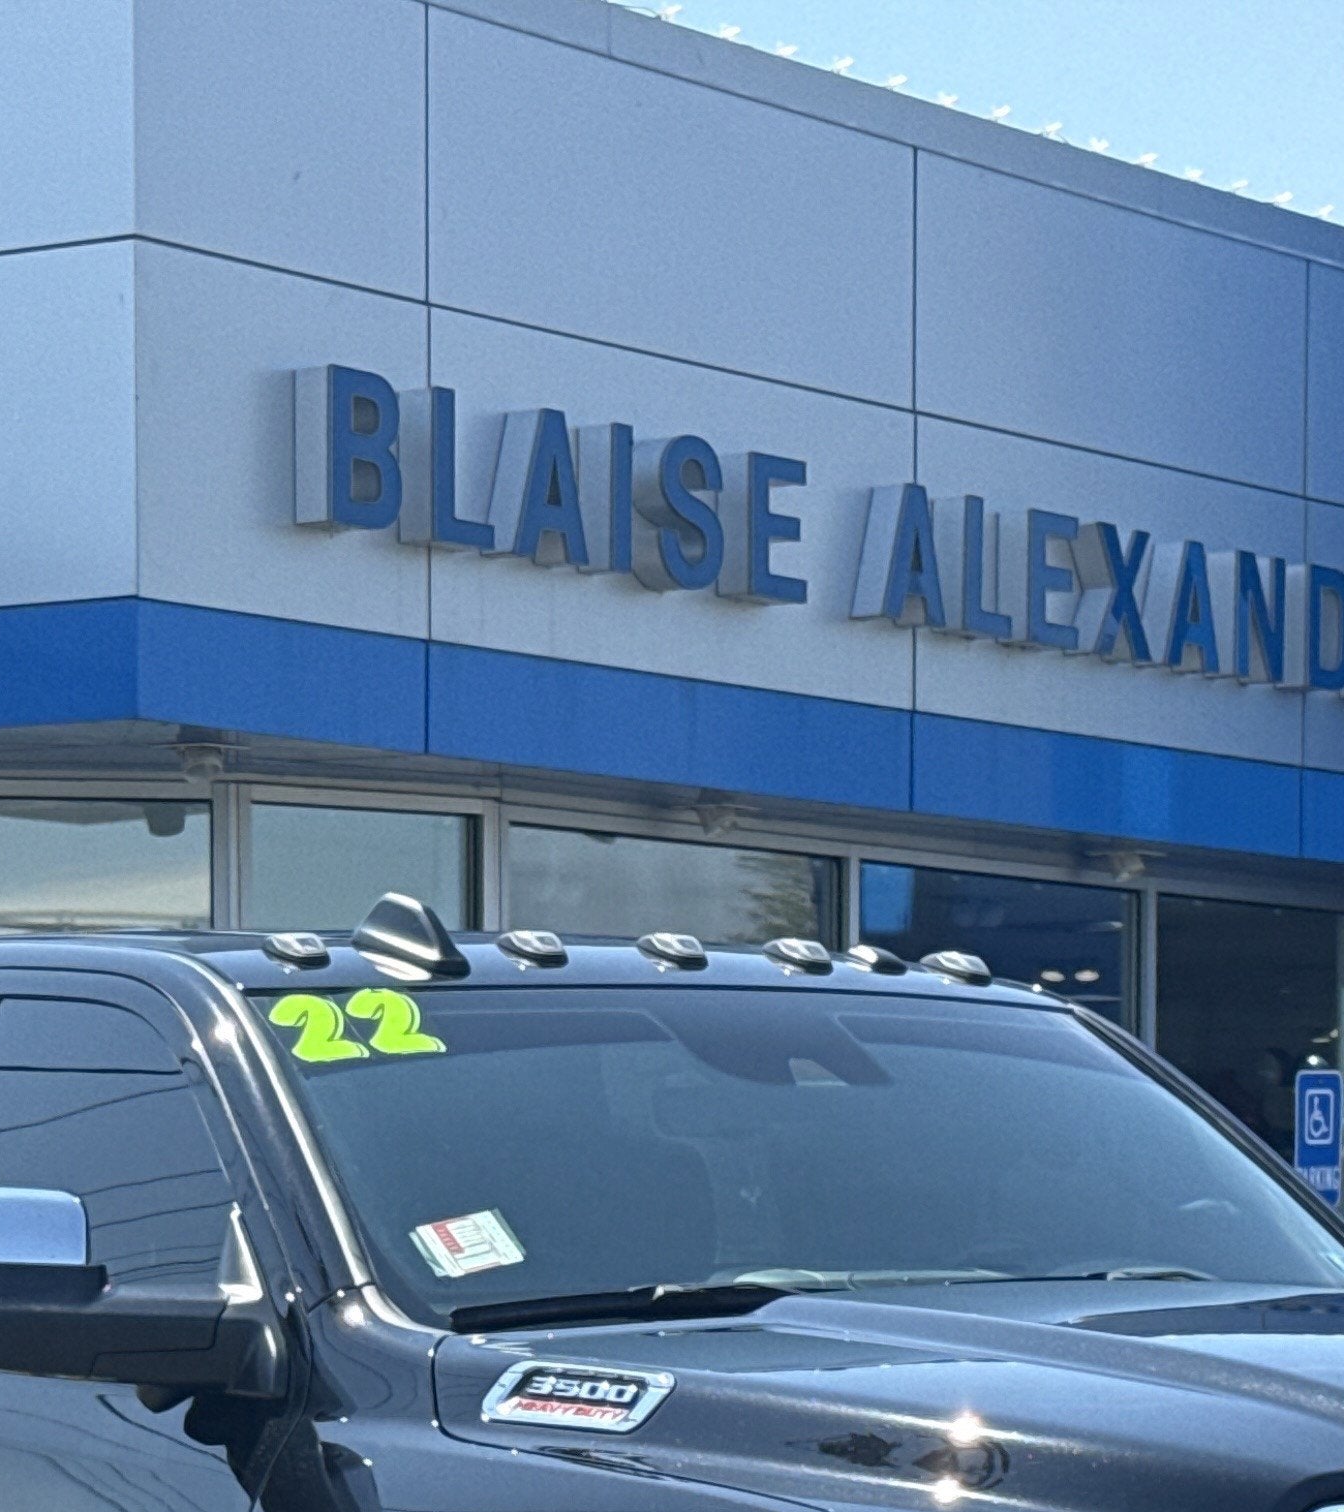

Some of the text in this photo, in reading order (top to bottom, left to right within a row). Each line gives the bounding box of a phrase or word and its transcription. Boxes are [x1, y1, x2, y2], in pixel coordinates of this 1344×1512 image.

[318, 362, 807, 604] BLAISE
[268, 987, 448, 1063] 22
[525, 1375, 640, 1404] 3500
